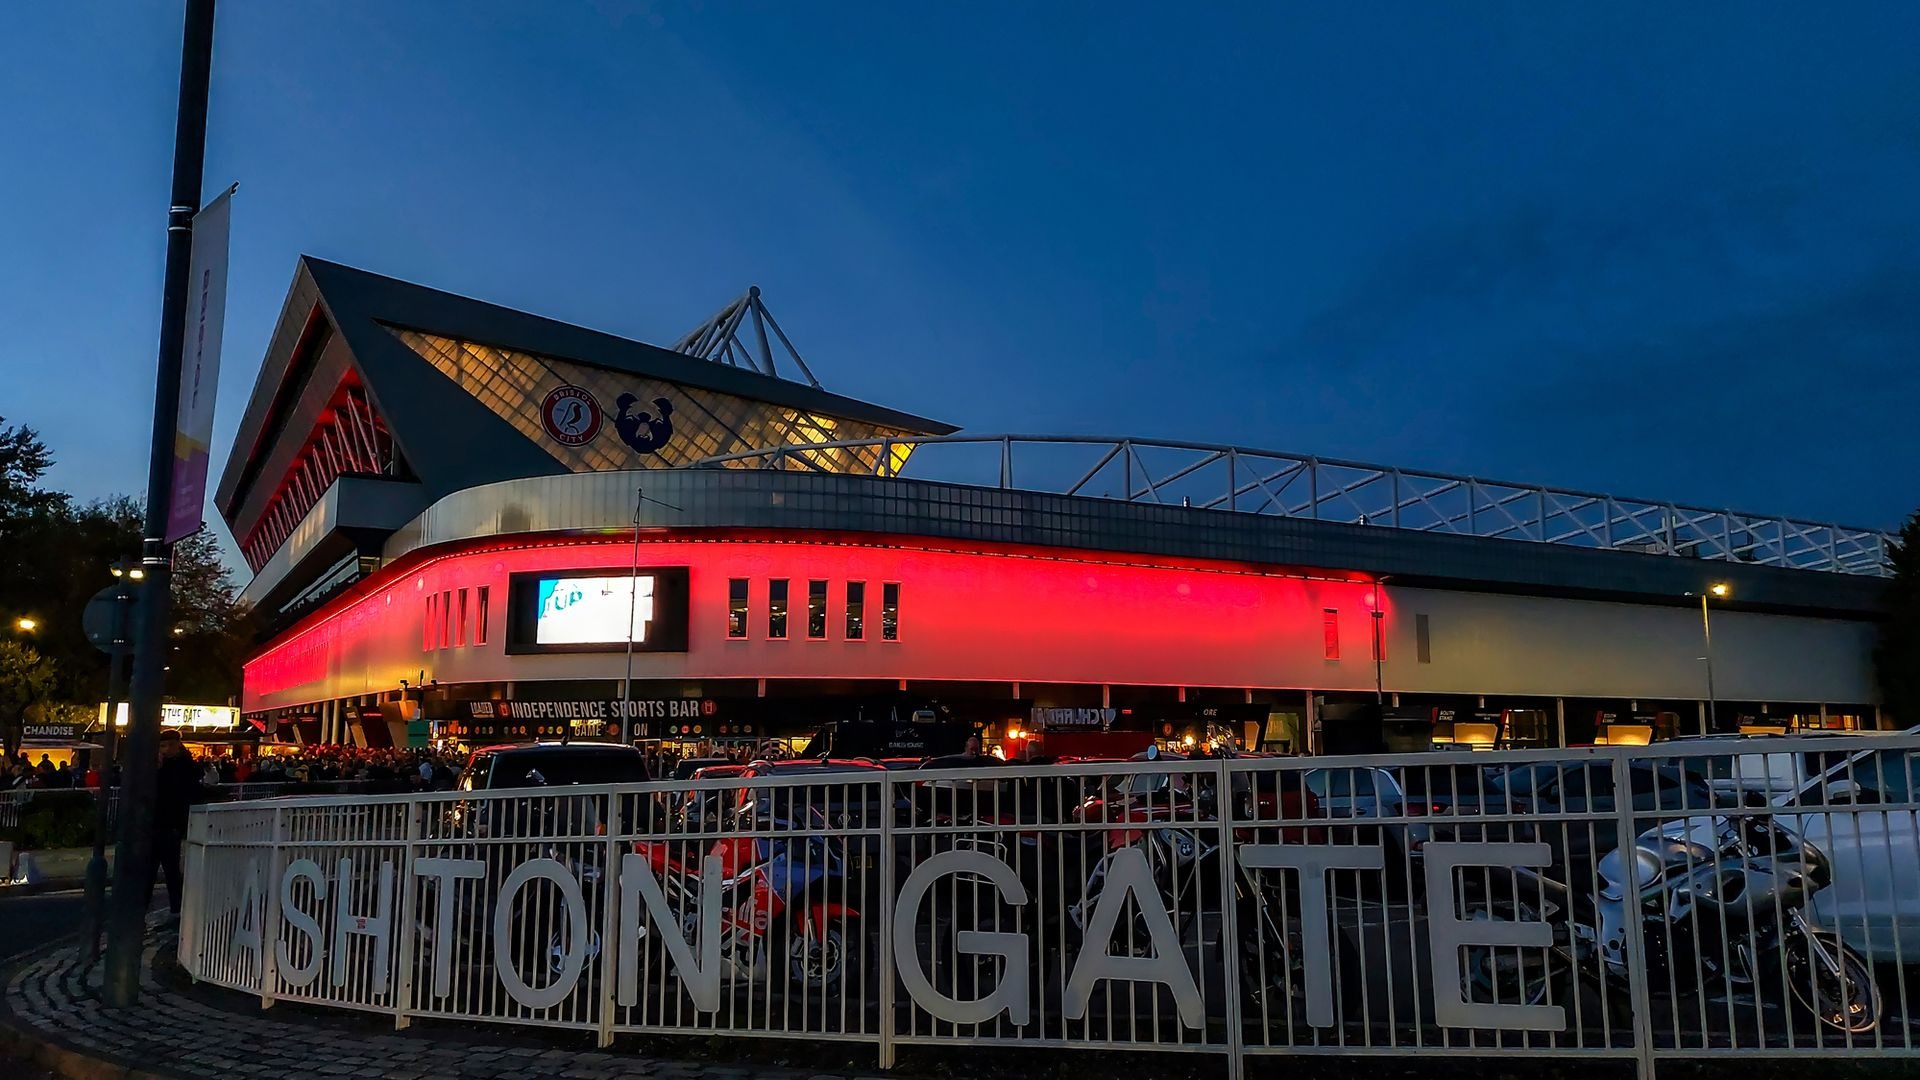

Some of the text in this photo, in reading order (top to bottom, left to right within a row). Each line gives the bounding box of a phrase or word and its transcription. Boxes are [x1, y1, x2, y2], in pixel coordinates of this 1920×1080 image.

[553, 389, 592, 405] BRISTOL
[560, 433, 584, 443] CITY
[470, 701, 493, 714] LOADED
[511, 700, 700, 718] INDEPENDENCE SPORTS BAR
[23, 725, 74, 736] CHANDISE
[574, 722, 602, 737] GAME
[634, 723, 648, 736] ON
[229, 842, 1567, 1032] ASHTON GATE
